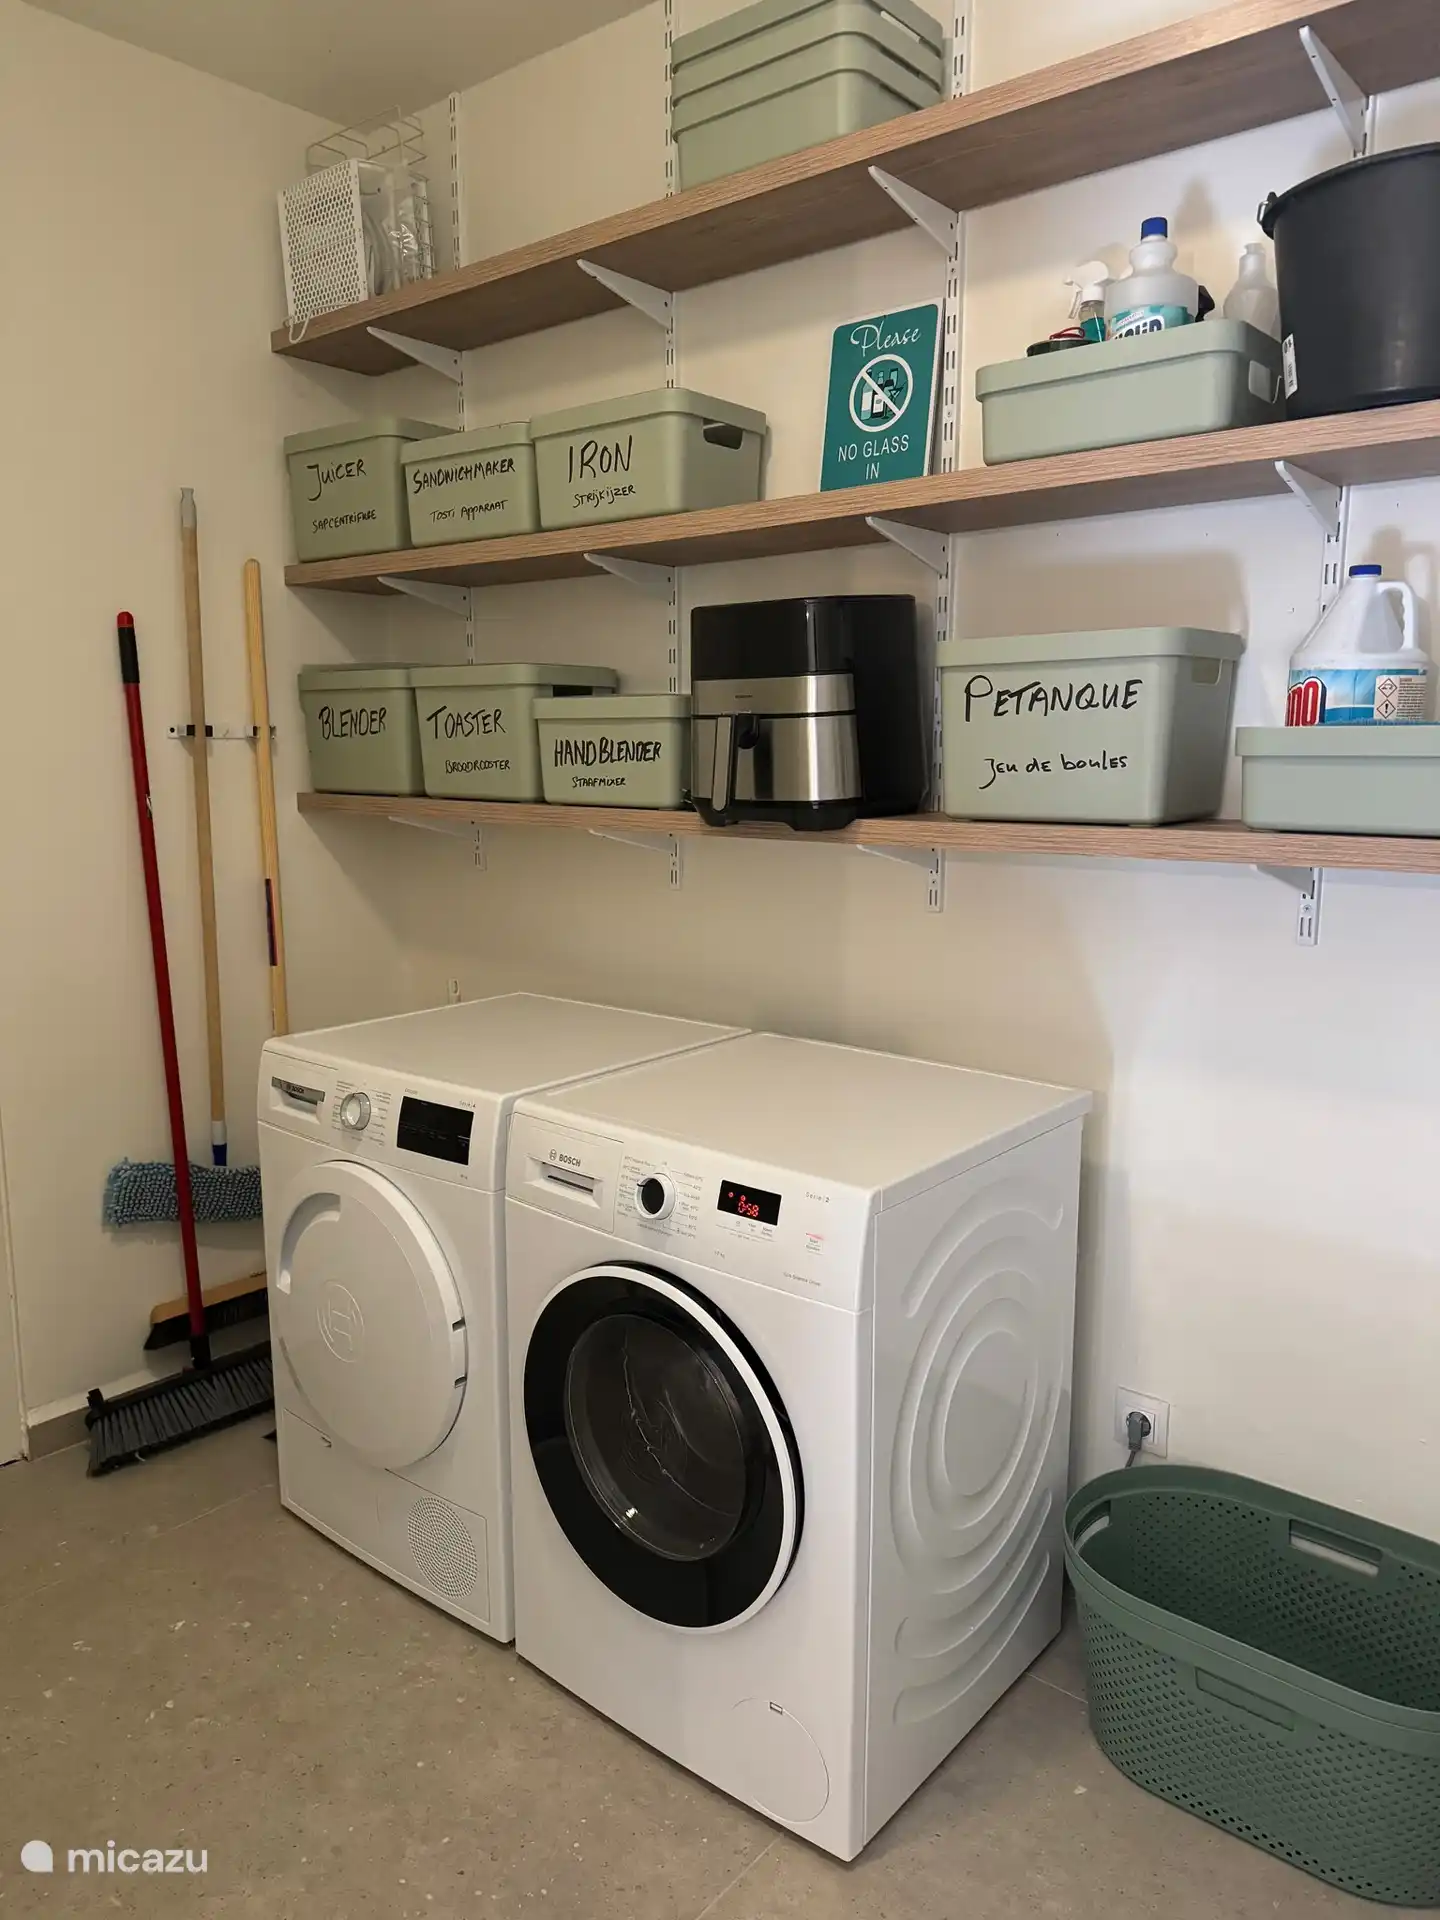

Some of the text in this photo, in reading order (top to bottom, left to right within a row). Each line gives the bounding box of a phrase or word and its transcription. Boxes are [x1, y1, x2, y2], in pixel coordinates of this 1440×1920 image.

[850, 320, 922, 358] Please
[568, 434, 633, 483] IRON
[838, 434, 910, 462] NO GLASS
[865, 463, 880, 481] IN
[963, 674, 1144, 723] PETANQUE
[318, 706, 387, 741] BLENDER
[426, 705, 506, 740] TOASTER
[445, 759, 511, 774] BROODROOSTER
[558, 1153, 581, 1167] BOSCH
